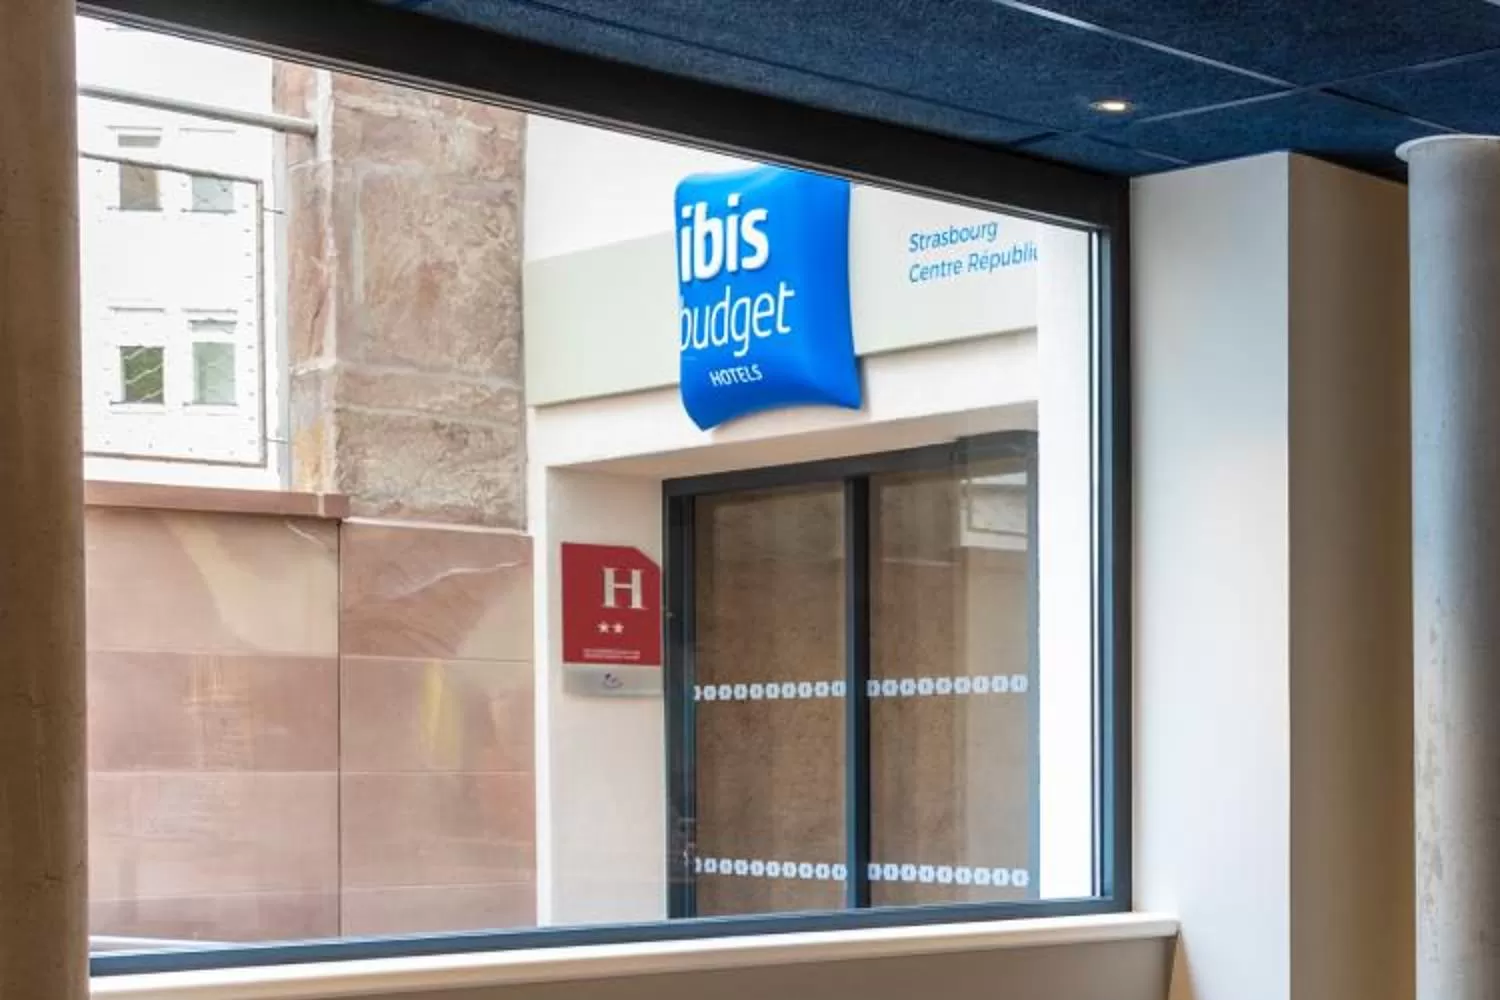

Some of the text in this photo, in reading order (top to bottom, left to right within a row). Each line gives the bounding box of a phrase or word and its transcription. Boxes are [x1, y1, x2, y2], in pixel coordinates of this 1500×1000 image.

[680, 192, 769, 283] ibis
[908, 221, 998, 252] Strasbourg
[909, 259, 963, 283] Centre
[708, 363, 764, 387] HOTELS
[600, 567, 649, 611] H
